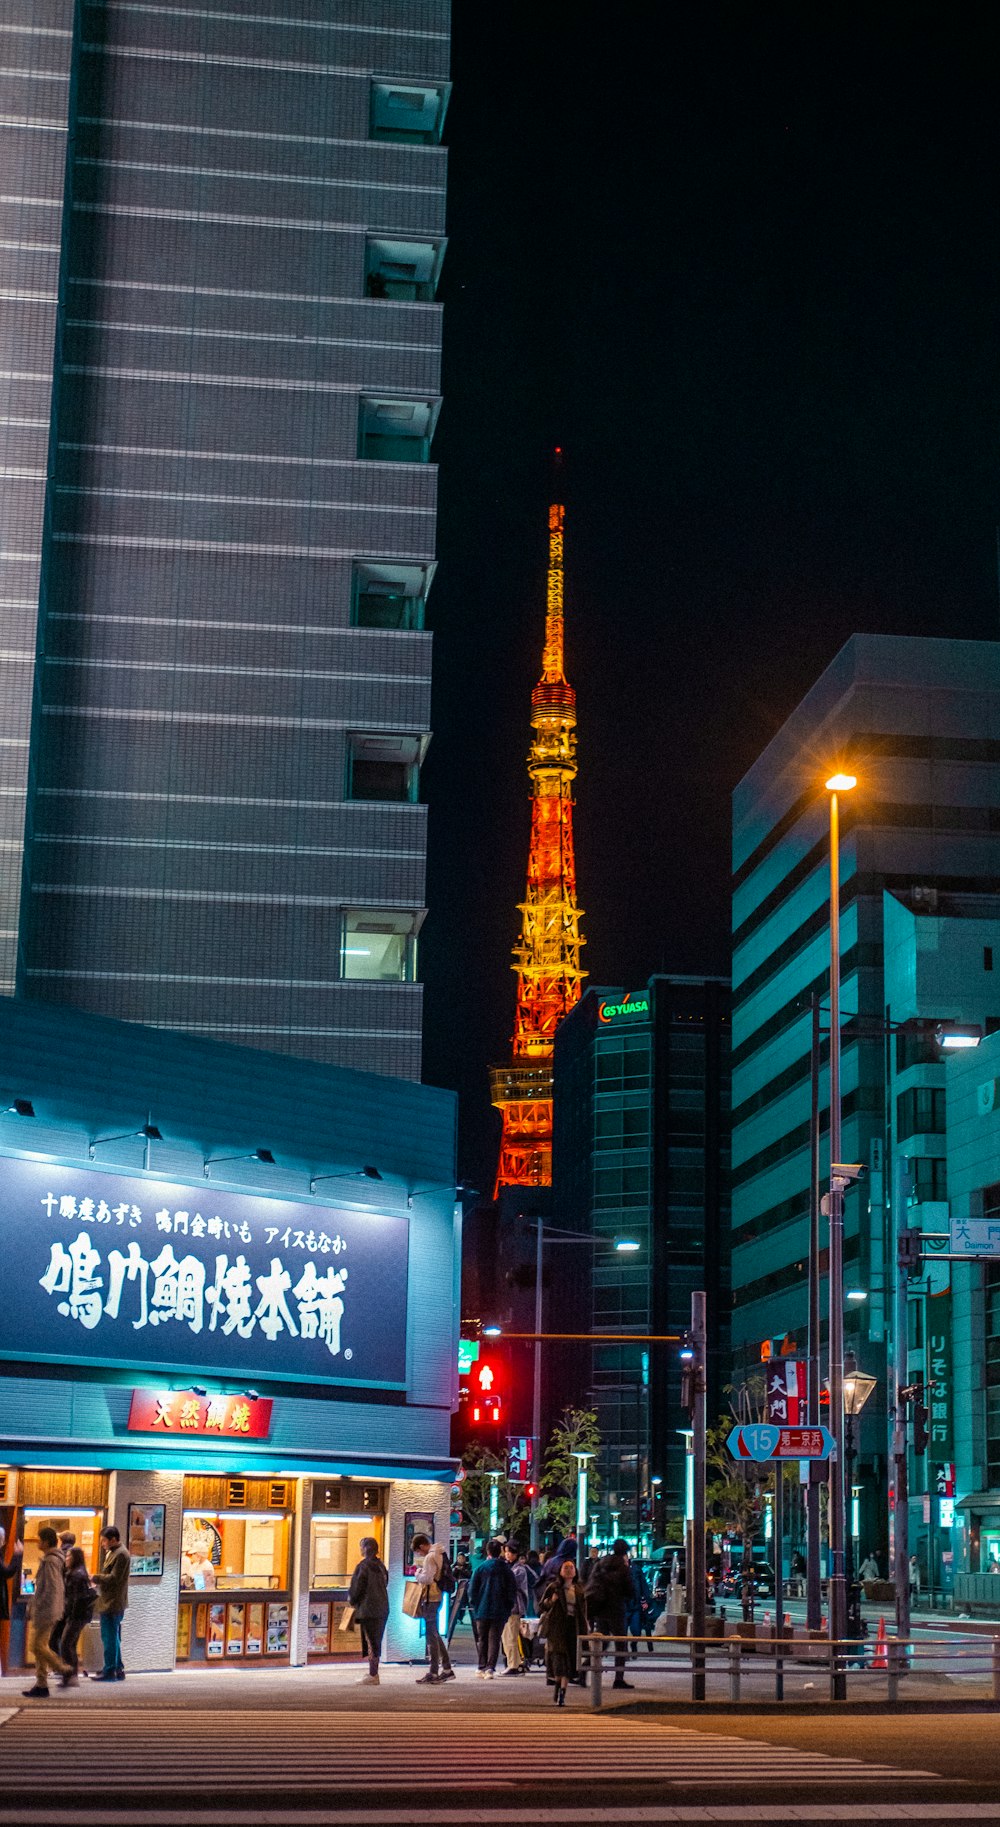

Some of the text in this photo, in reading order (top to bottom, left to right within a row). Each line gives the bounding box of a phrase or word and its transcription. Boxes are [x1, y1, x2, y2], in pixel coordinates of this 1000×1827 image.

[41, 1192, 347, 1255] 十勝産あずき 鳴門金時いも アイスもなか
[965, 1241, 994, 1249] Daimon
[38, 1231, 348, 1356] 鳴門鯛焼本舗
[768, 1375, 788, 1419] 大門
[153, 1400, 251, 1432] 天然鯛焼
[750, 1429, 772, 1451] 15
[781, 1431, 821, 1447] 第一京浜
[508, 1446, 521, 1474] 大門
